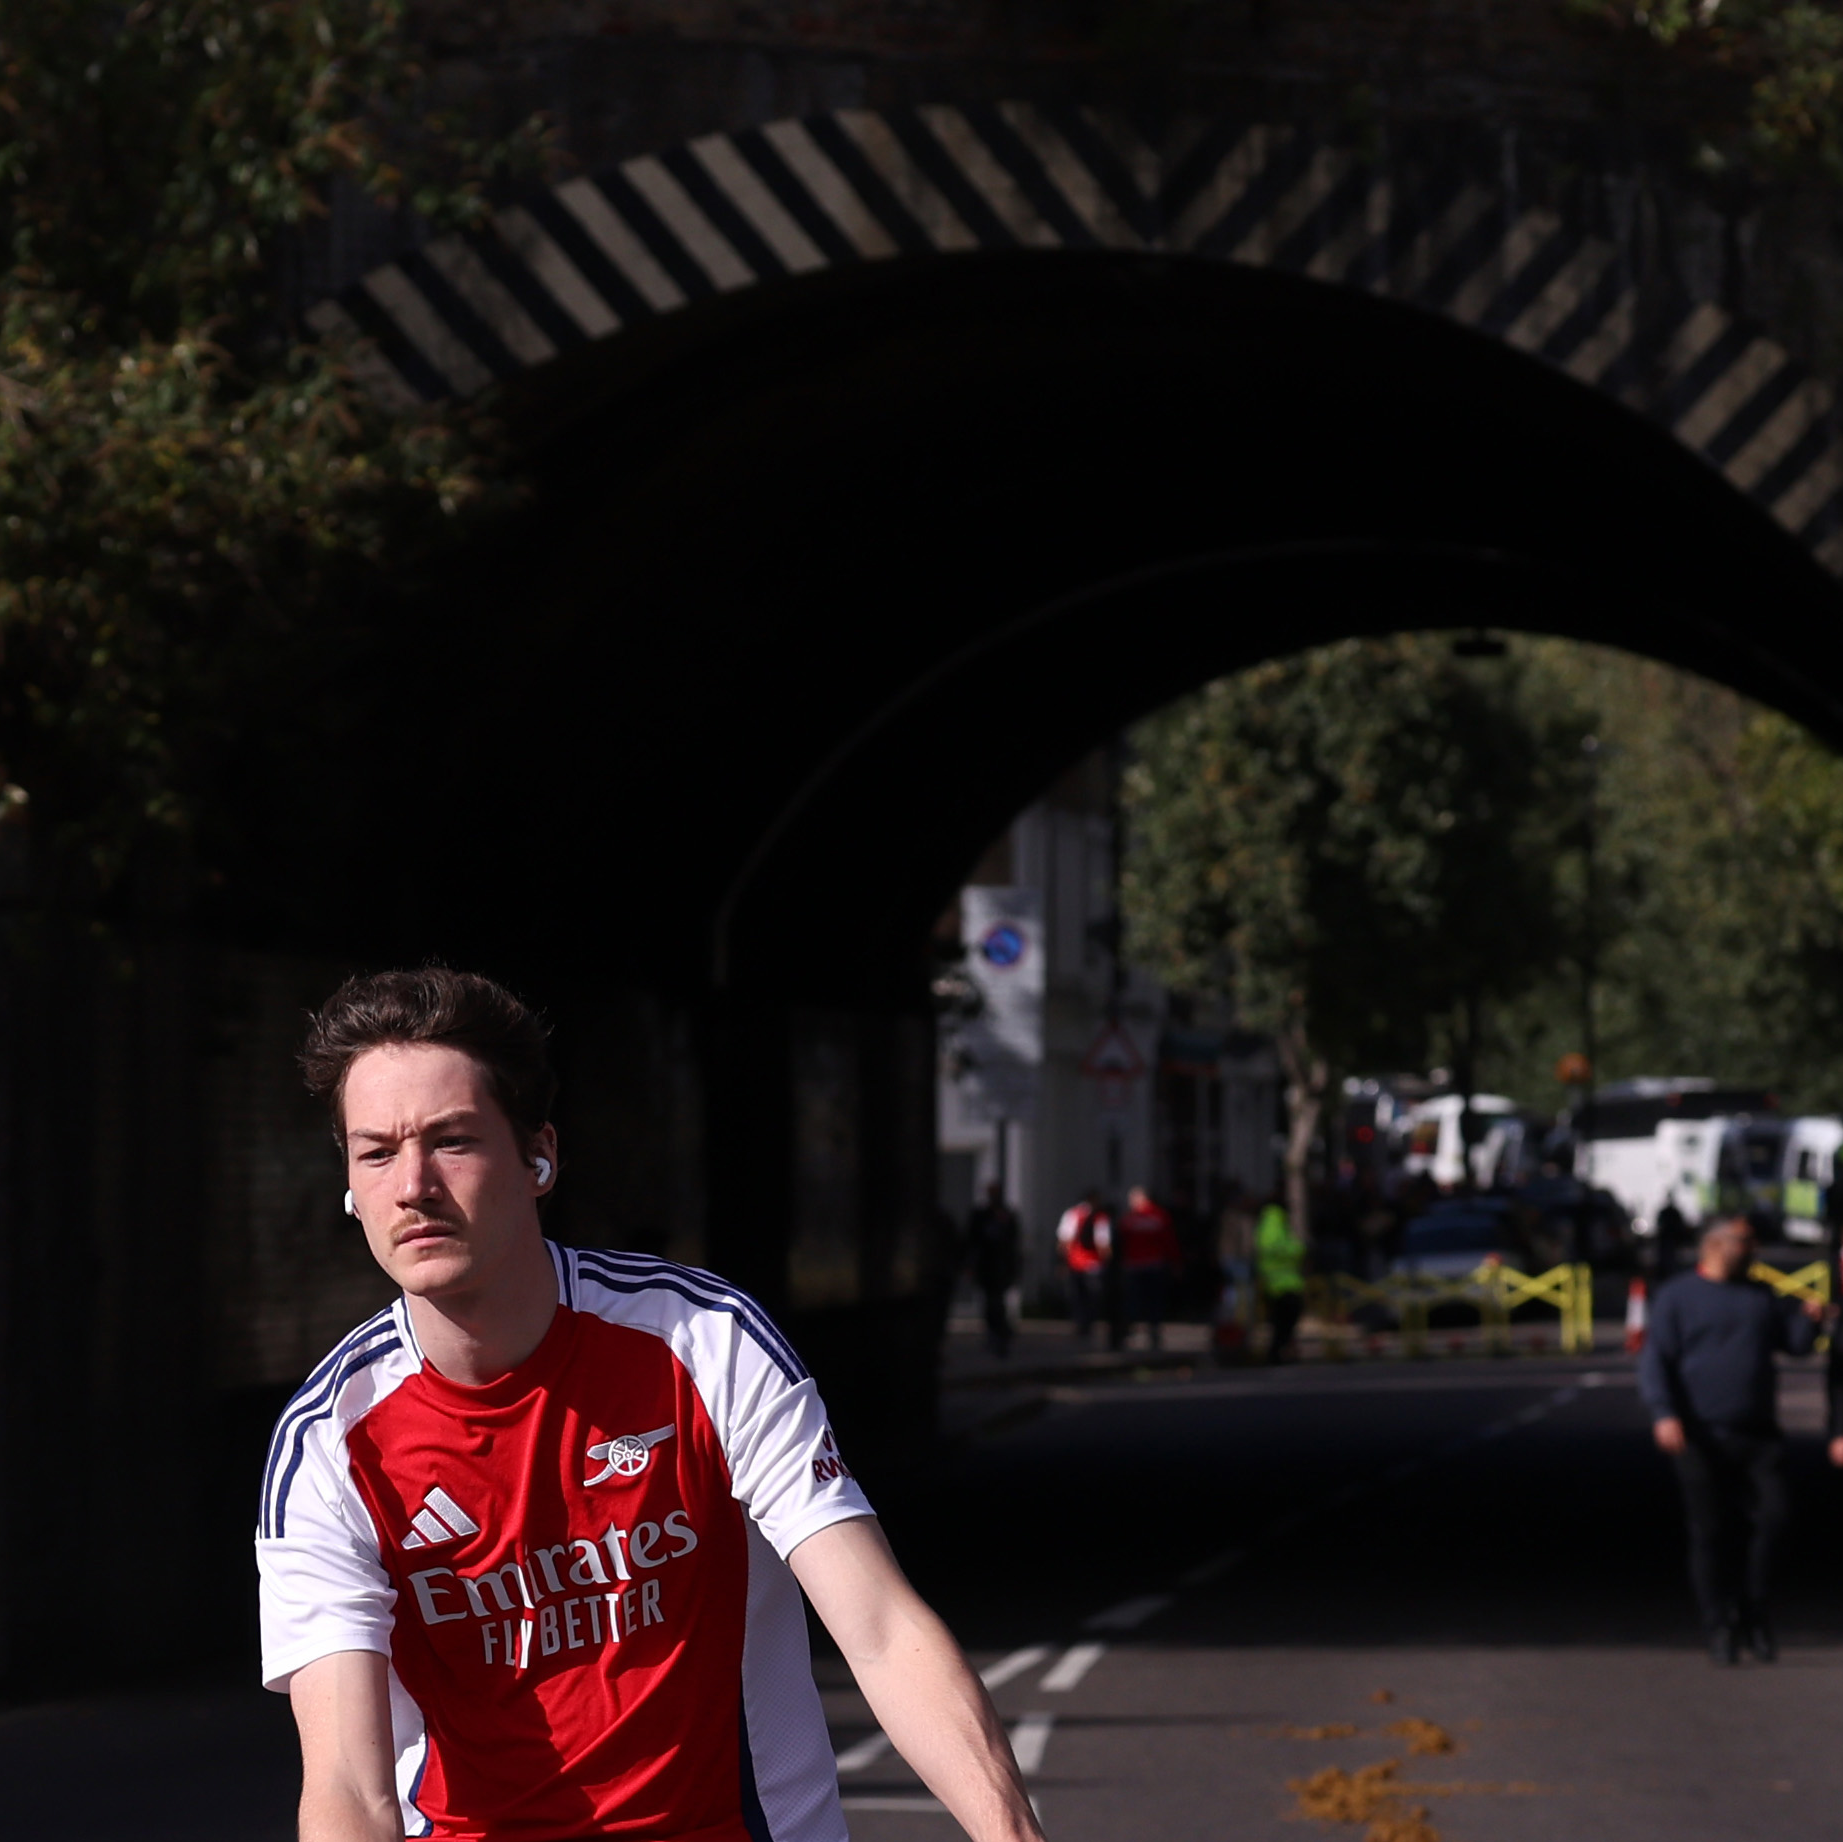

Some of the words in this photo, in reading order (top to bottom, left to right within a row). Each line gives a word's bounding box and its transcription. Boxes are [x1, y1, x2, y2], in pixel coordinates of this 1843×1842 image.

[408, 1510, 698, 1625] Emirates
[481, 1618, 533, 1669] FLY
[540, 1578, 665, 1656] BETTER
